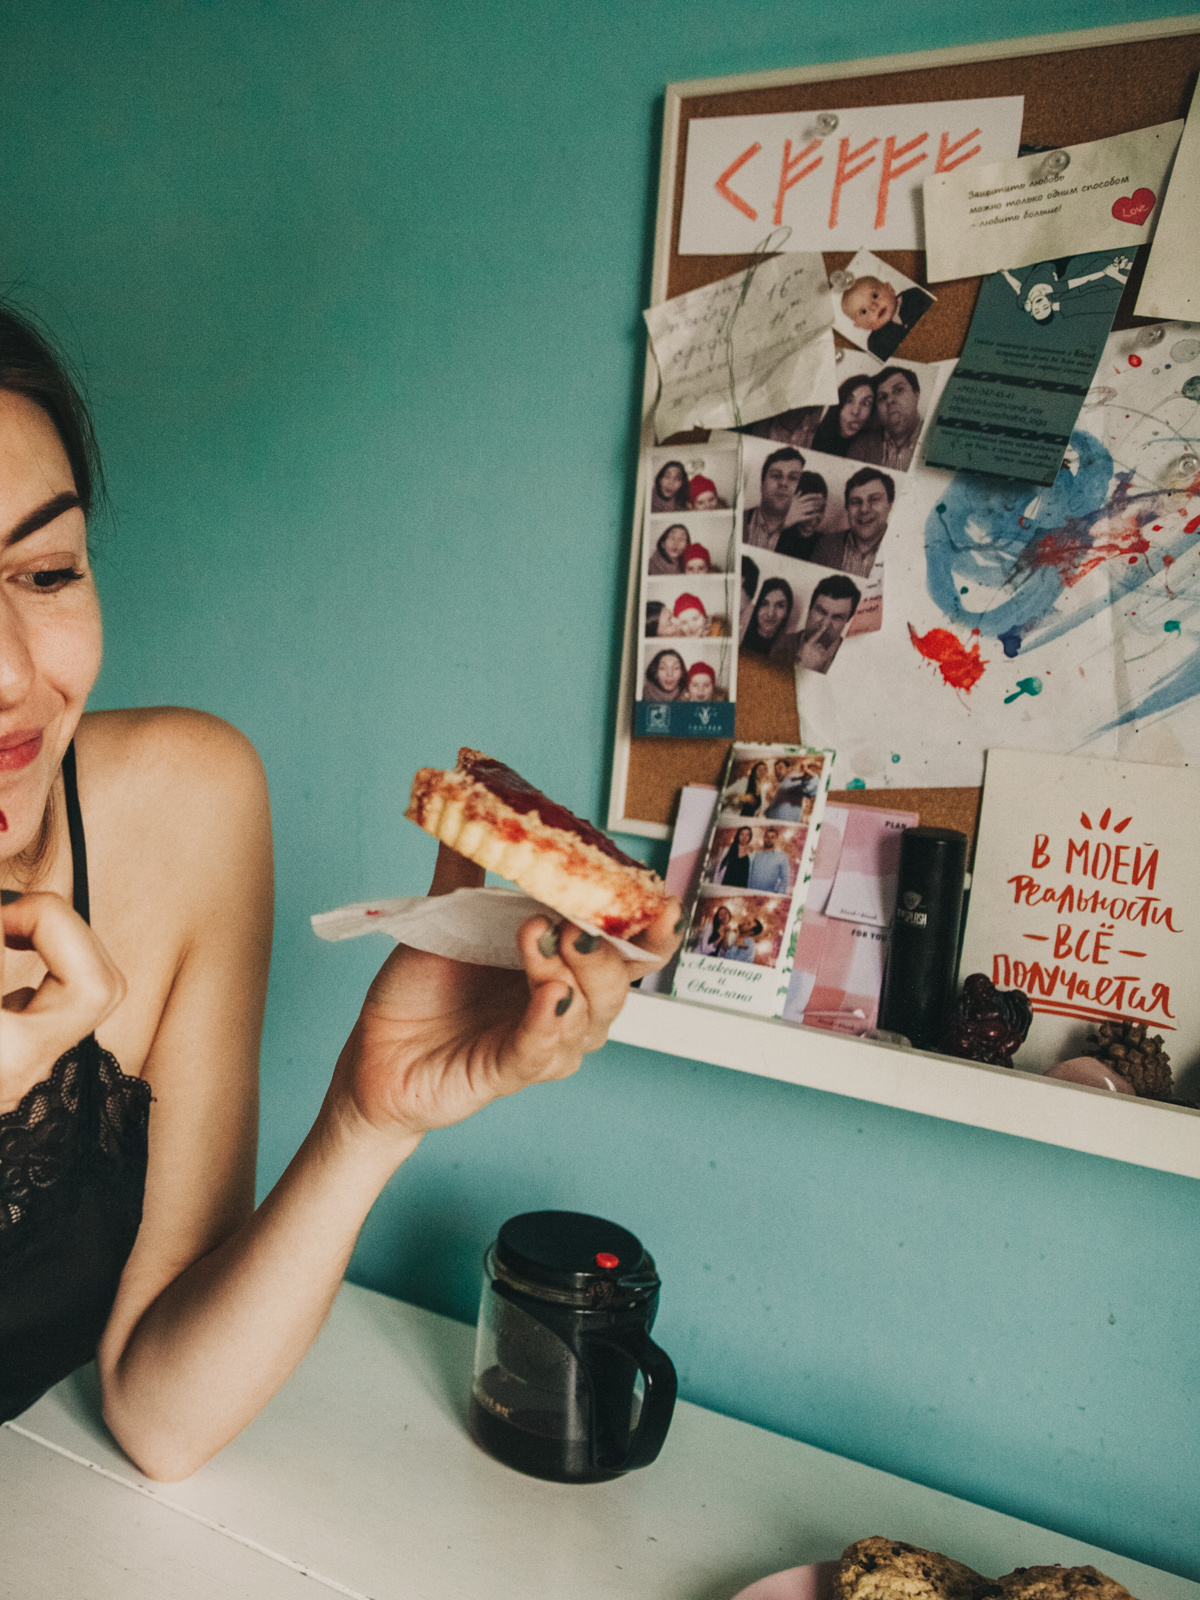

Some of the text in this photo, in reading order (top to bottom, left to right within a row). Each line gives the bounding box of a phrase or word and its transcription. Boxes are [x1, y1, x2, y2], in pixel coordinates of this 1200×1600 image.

[967, 172, 1065, 200] Защитить любовь
[969, 175, 1130, 215] можно только одним способом
[979, 215, 1020, 227] любить
[1023, 204, 1062, 220] больше!
[1031, 834, 1160, 891] В МОЕЙ
[851, 928, 868, 938] FOR
[687, 957, 763, 983] Александр
[687, 979, 753, 1003] Светлана
